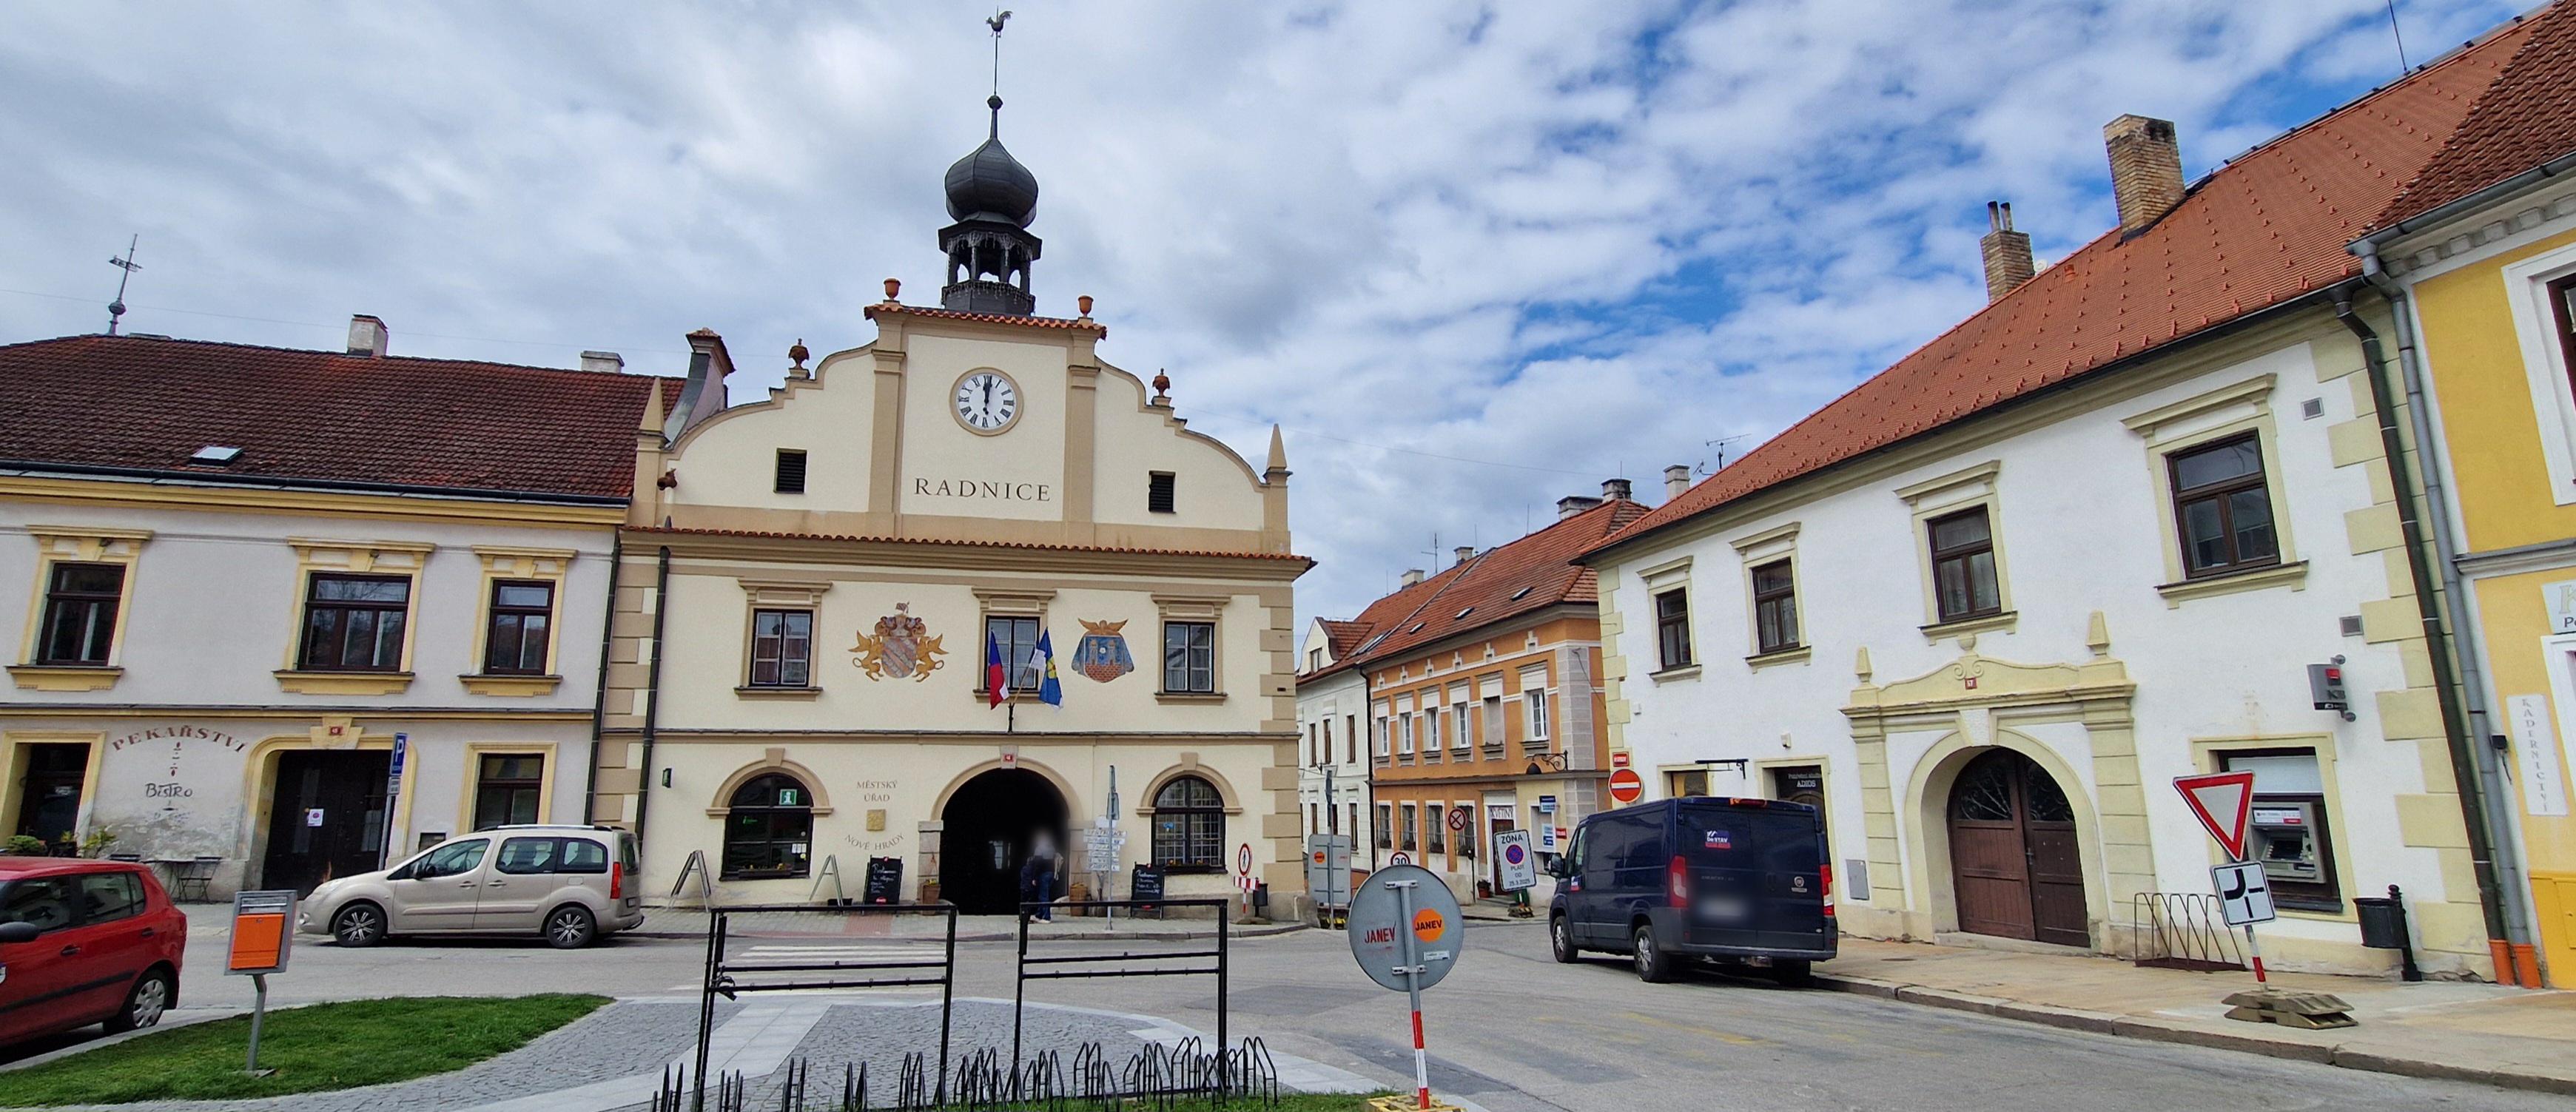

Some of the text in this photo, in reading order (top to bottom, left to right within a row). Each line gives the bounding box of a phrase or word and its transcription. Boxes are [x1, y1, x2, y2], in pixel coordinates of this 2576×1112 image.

[914, 477, 1051, 502] RADNICE
[857, 779, 898, 789] MĚSTSKÝ
[863, 792, 890, 802] ÚŘAD
[844, 832, 905, 851] NOVÉ HRADY
[1415, 920, 1442, 931] JANEV
[1365, 926, 1396, 944] JANEV
